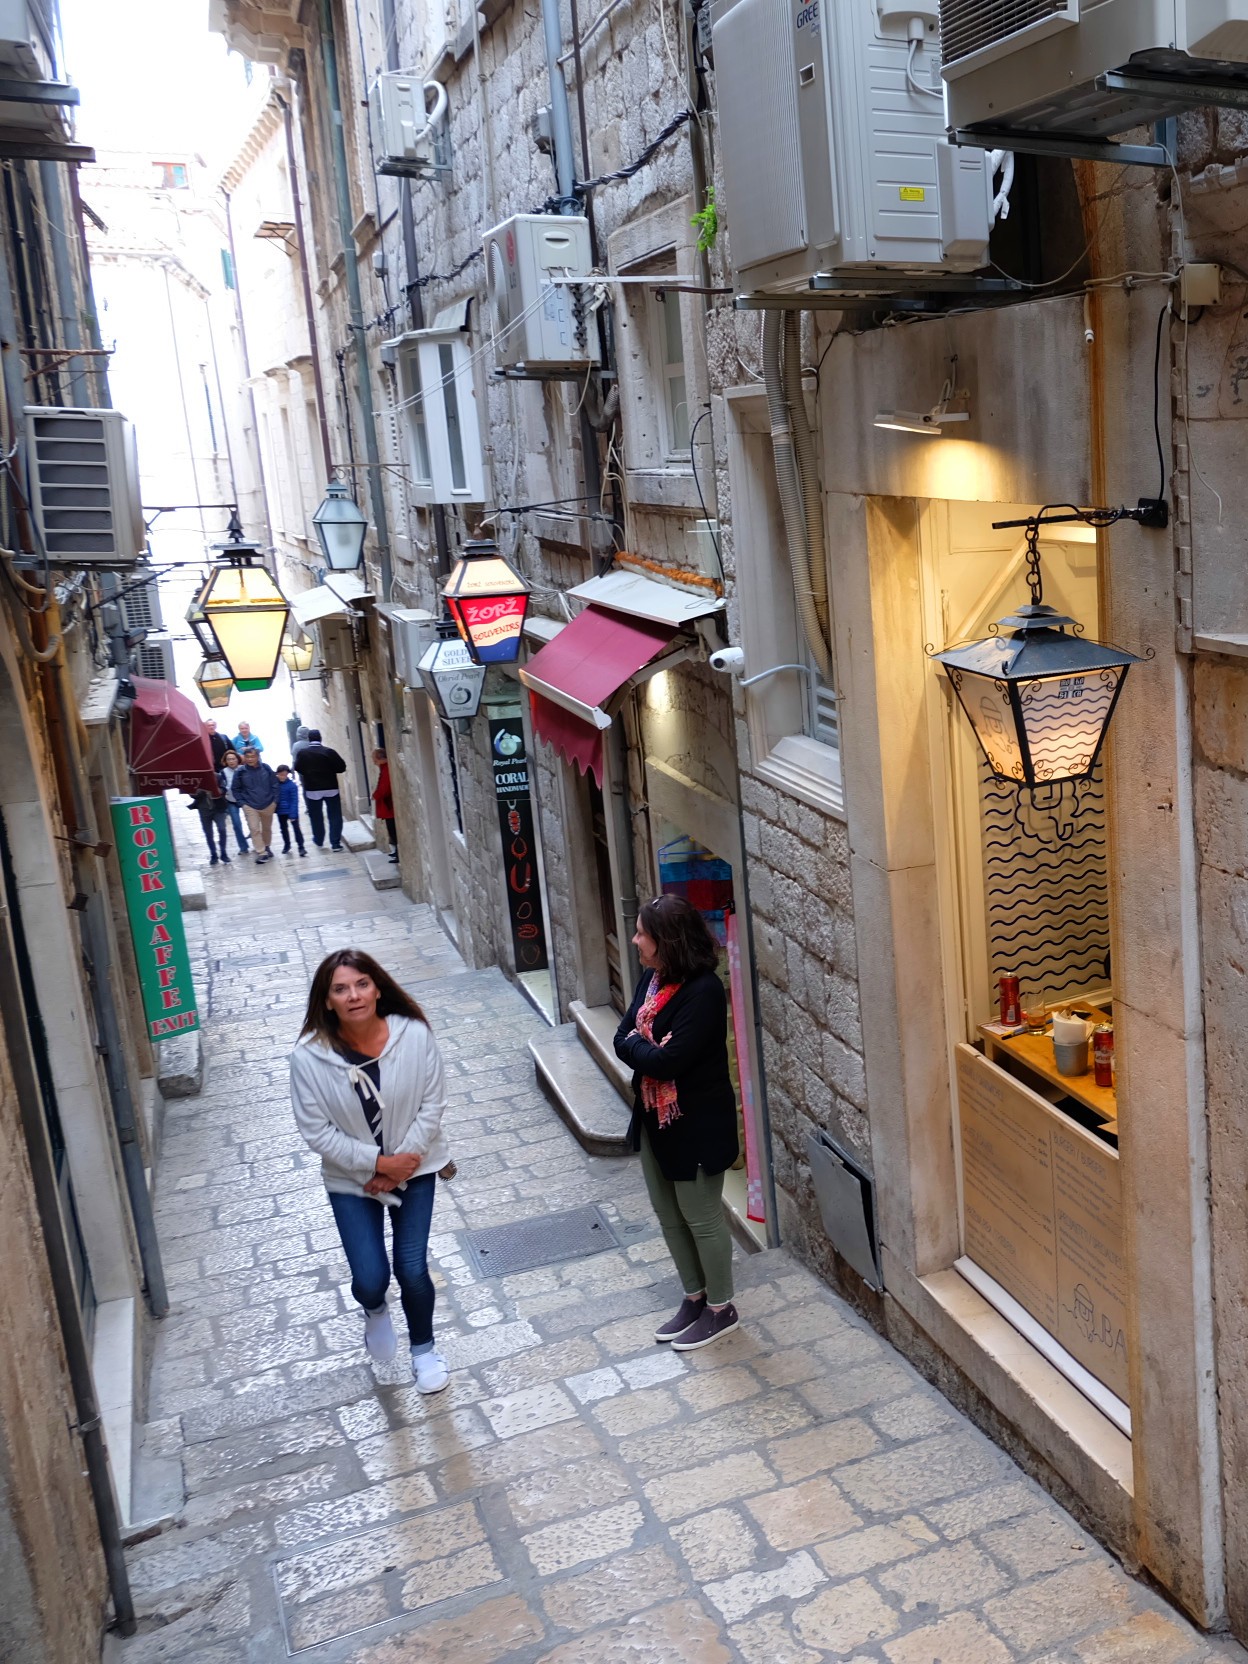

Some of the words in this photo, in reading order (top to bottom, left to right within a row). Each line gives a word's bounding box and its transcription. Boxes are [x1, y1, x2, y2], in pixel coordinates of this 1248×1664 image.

[797, 1, 818, 28] GREE
[467, 597, 519, 622] ŽORŽ
[473, 622, 520, 642] SOUVENIRS
[492, 758, 511, 767] Royal
[140, 774, 204, 788] Jewellery
[495, 771, 530, 785] CORAL
[128, 805, 165, 893] ROCK
[146, 901, 182, 1010] CAFFE
[150, 1010, 197, 1037] EXIT
